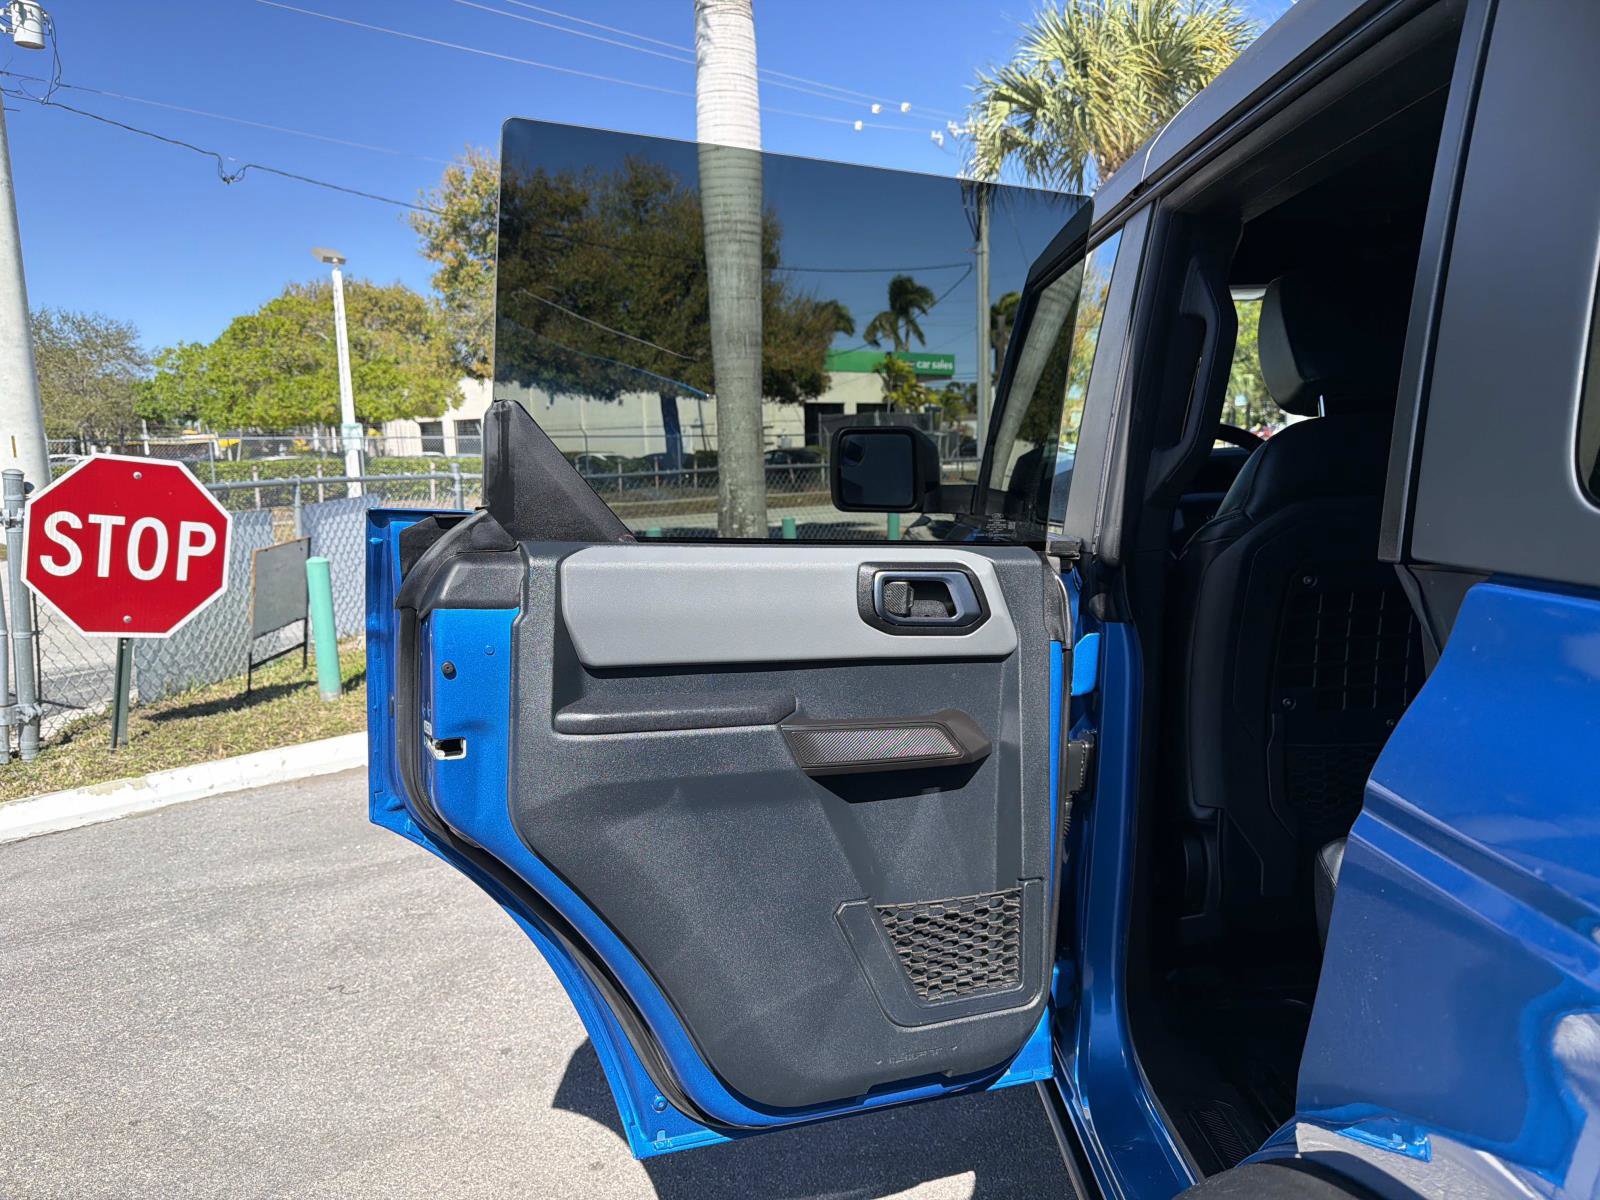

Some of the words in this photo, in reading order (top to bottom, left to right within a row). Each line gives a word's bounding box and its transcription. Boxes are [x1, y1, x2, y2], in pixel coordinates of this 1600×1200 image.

[916, 360, 930, 369] car
[932, 359, 953, 370] sales
[39, 510, 217, 582] STOP
